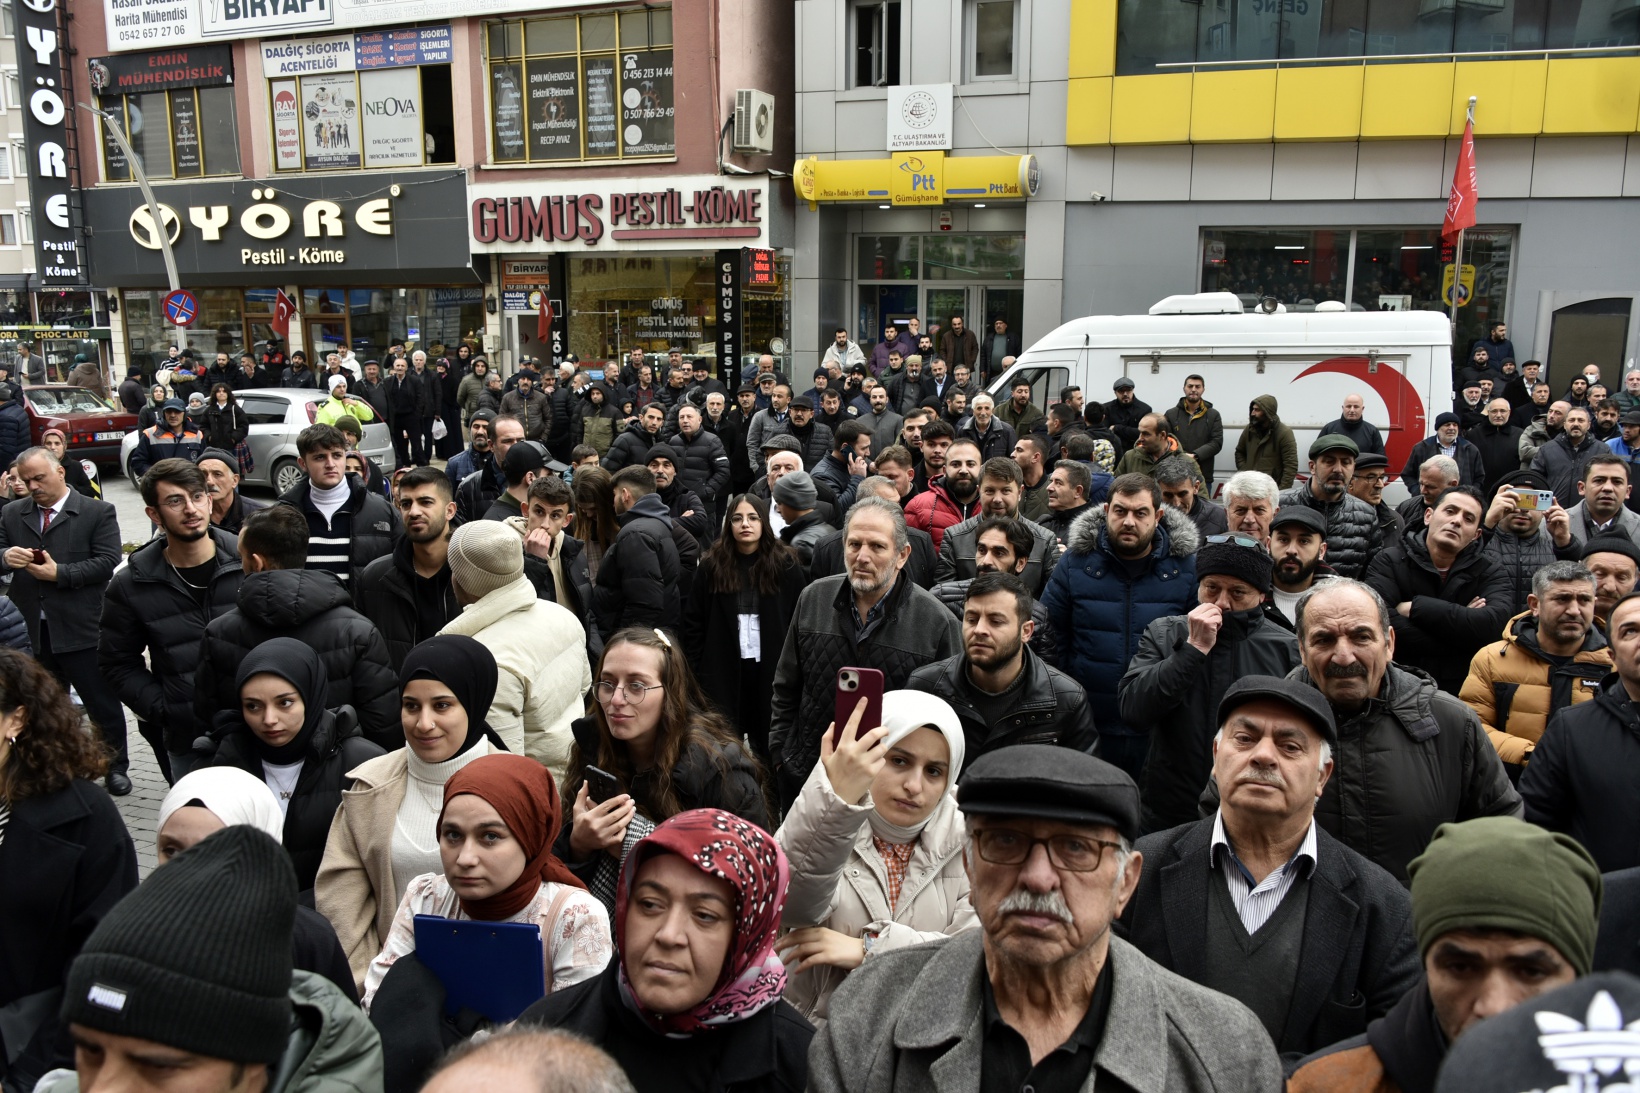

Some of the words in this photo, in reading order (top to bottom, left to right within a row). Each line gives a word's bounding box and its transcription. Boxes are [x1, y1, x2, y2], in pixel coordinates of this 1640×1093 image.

[115, 13, 140, 27] Harita
[142, 7, 188, 24] Mühendisi
[120, 30, 140, 41] 0542
[143, 28, 158, 38] 657
[161, 27, 171, 36] 27
[174, 25, 185, 35] 06
[361, 33, 383, 43] Trafik
[393, 31, 417, 40] Kasko
[420, 29, 448, 39] SİGORTA
[265, 44, 303, 59] DALĞIÇ
[306, 41, 350, 55] SİGORTA
[362, 45, 382, 54] DASK
[394, 42, 416, 51] Konut
[420, 40, 450, 52] İŞLEMLERİ
[148, 51, 188, 67] EMİN
[362, 56, 386, 66] Sağlık
[394, 52, 415, 63] İşyeri
[423, 52, 447, 60] YAPILIR
[280, 55, 338, 73] ACENTELİĞİ
[118, 64, 224, 86] MÜHENDİSLİK
[531, 74, 545, 83] EMİN
[545, 71, 575, 82] MÜHENDİSLİK
[623, 71, 628, 80] 0
[629, 70, 642, 79] 456
[643, 69, 654, 78] 213
[656, 68, 663, 77] 14
[663, 67, 673, 77] 44
[532, 87, 575, 98] Elektrik-Elektronik
[275, 100, 295, 111] RAY
[365, 97, 416, 116] NEOVA
[624, 110, 629, 119] 0
[629, 110, 642, 119] 507
[642, 109, 655, 118] 766
[656, 108, 664, 117] 29
[665, 108, 674, 117] 49
[26, 26, 69, 228] YÖRE
[532, 120, 547, 131] İnşaat
[548, 118, 577, 130] Mühendisliği
[278, 128, 296, 137] Sigorta
[540, 136, 555, 145] RECEP
[556, 134, 570, 144] AYVAZ
[913, 174, 935, 191] Ptt
[989, 183, 1019, 194] PttBank
[895, 194, 938, 203] Gümüşhane
[188, 188, 394, 241] YÖRE
[472, 194, 604, 245] GÜMÜŞ
[610, 186, 762, 226] PESTİL-KÖME
[43, 240, 76, 251] Pestil
[57, 255, 64, 264] &
[241, 248, 285, 265] Pestil
[299, 247, 344, 264] Köme
[45, 266, 77, 277] Köme
[504, 291, 526, 299] DALĞIÇ
[722, 262, 732, 323] GÜMÜŞ
[652, 296, 683, 312] GÜMÜŞ
[637, 314, 667, 326] PESTİL
[673, 314, 698, 326] KÖME
[34, 331, 89, 339] CHOCLATE
[635, 330, 658, 338] FABRİKA
[674, 330, 702, 338] MAĞAZASI
[724, 332, 733, 390] PESTİ
